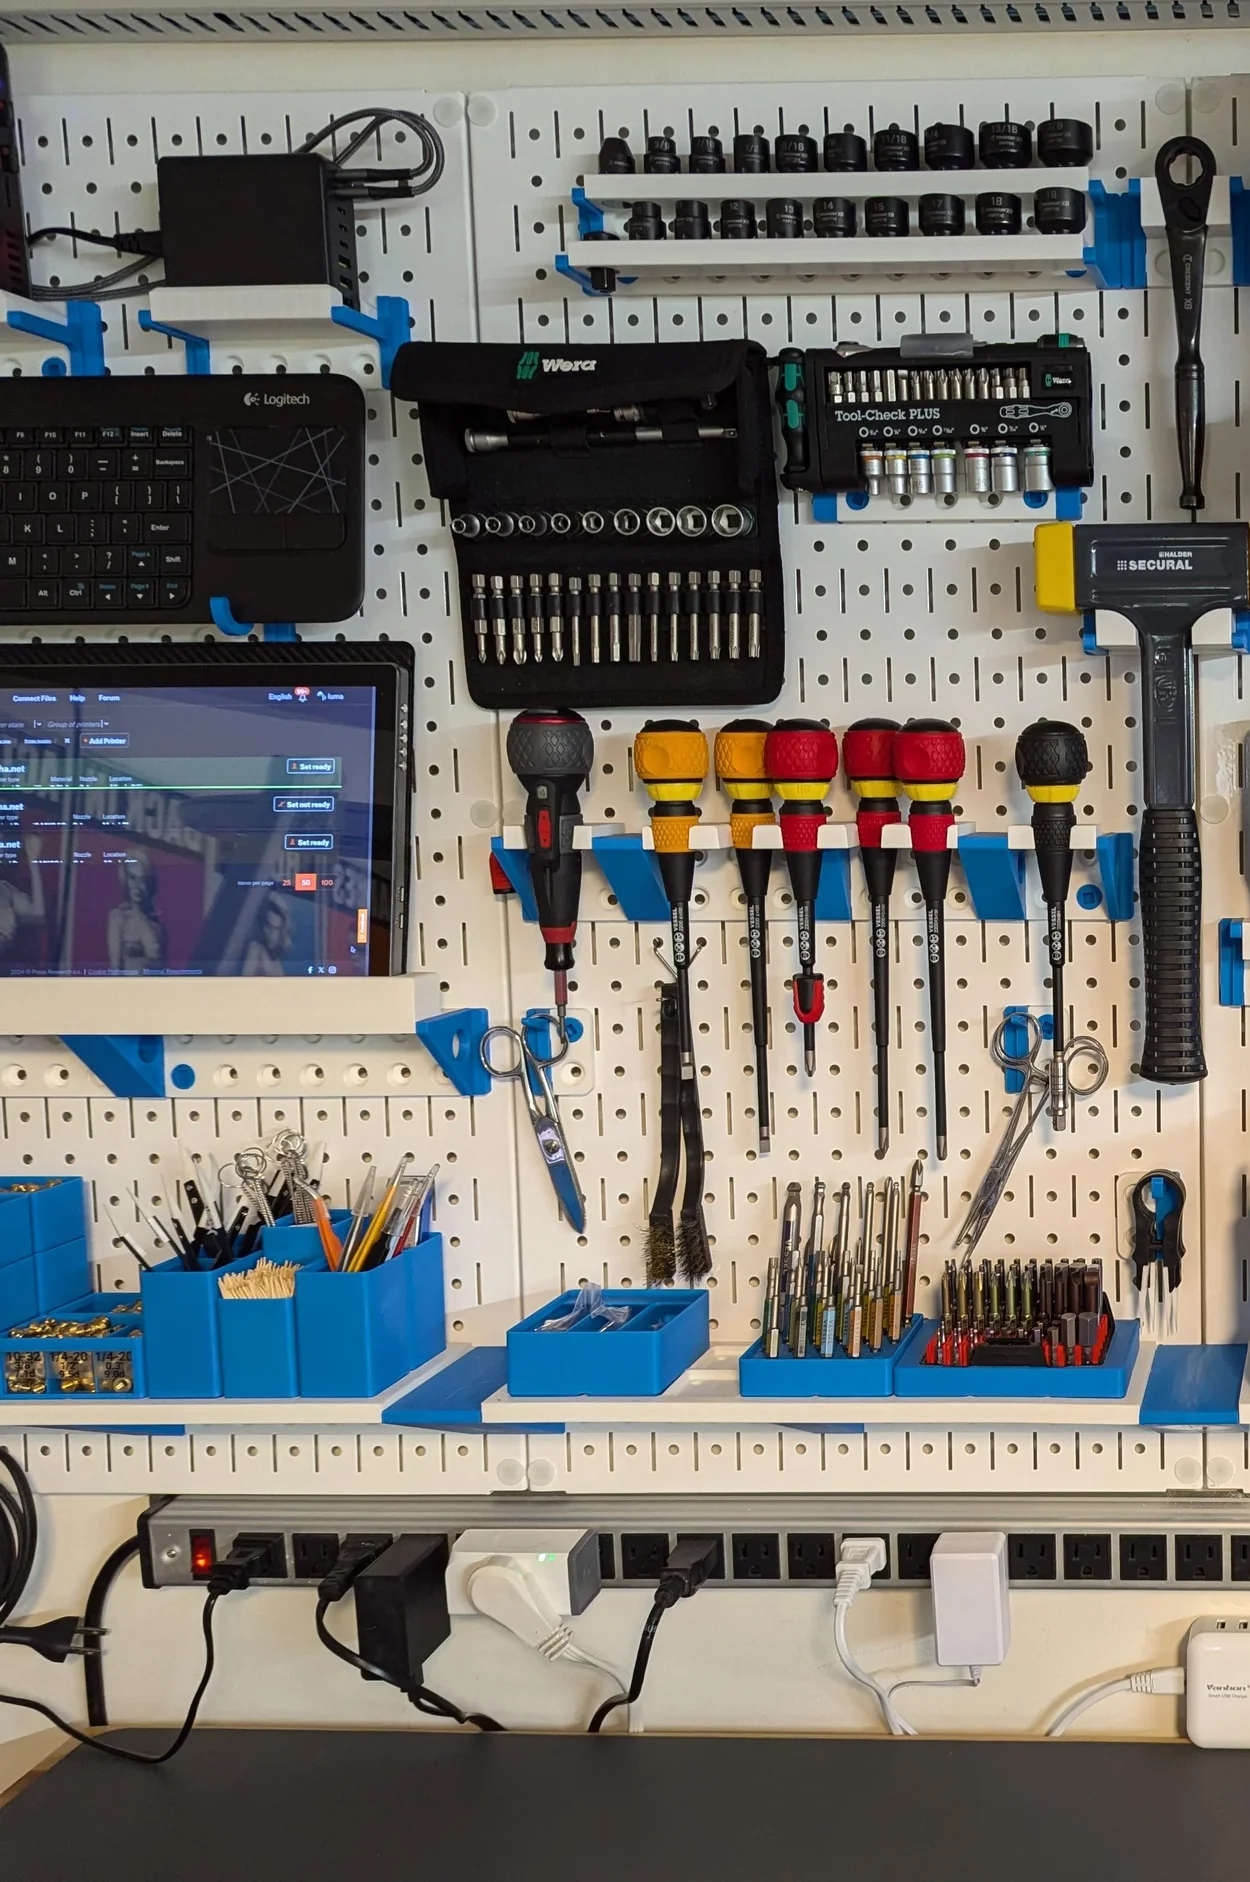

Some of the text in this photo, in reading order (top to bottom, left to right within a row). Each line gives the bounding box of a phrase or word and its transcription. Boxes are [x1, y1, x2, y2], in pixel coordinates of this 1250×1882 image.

[784, 204, 794, 214] 13
[541, 358, 597, 373] Wera
[264, 393, 310, 407] Logitech
[834, 408, 941, 422] Tool-Check PLUS
[162, 430, 183, 438] Delete
[150, 524, 170, 532] Enter
[1128, 559, 1193, 571] SECURAL
[69, 589, 82, 597] Ctrl
[12, 694, 57, 702] Connect Files
[69, 694, 86, 703] Help
[98, 694, 120, 702] Forum
[268, 692, 292, 701] English
[327, 692, 344, 700] luma
[47, 720, 67, 730] Group
[76, 721, 101, 729] printers
[89, 737, 127, 745] Add Printer
[312, 763, 332, 771] ready
[286, 800, 331, 809] Set not ready
[297, 838, 330, 847] Set ready
[7, 1352, 41, 1361] 10-32
[49, 1352, 88, 1361] 1/4-20
